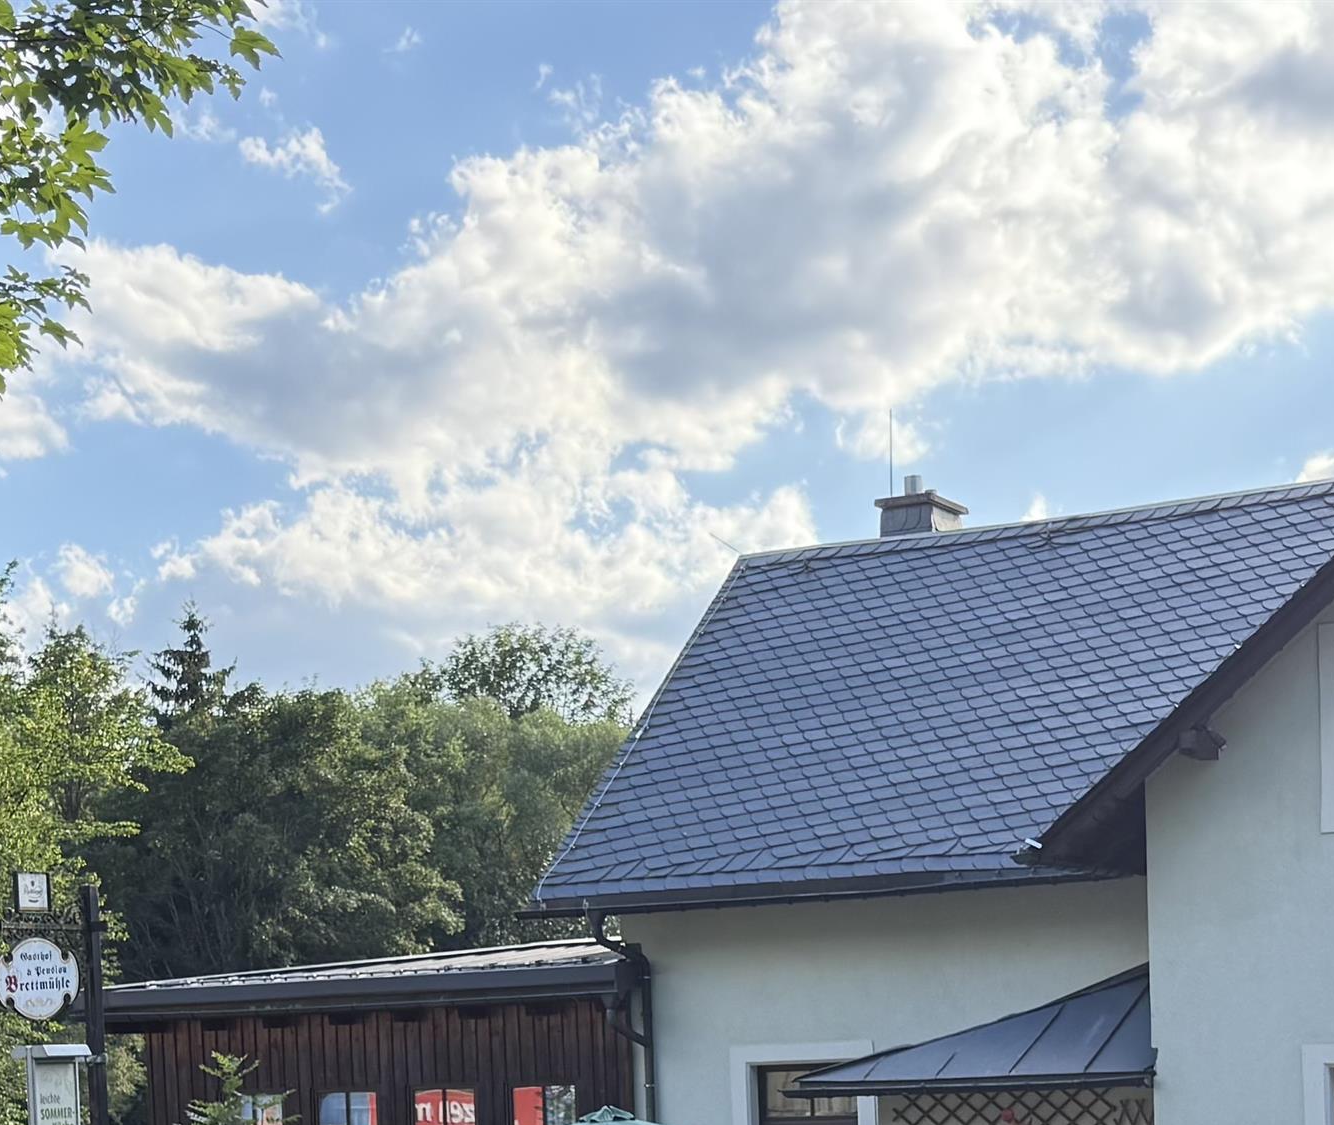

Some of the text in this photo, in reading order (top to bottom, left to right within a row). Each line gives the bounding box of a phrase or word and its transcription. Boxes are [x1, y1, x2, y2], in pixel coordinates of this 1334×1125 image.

[20, 951, 53, 962] Gasthof
[35, 965, 67, 977] Pension
[5, 975, 70, 993] Brettmühle
